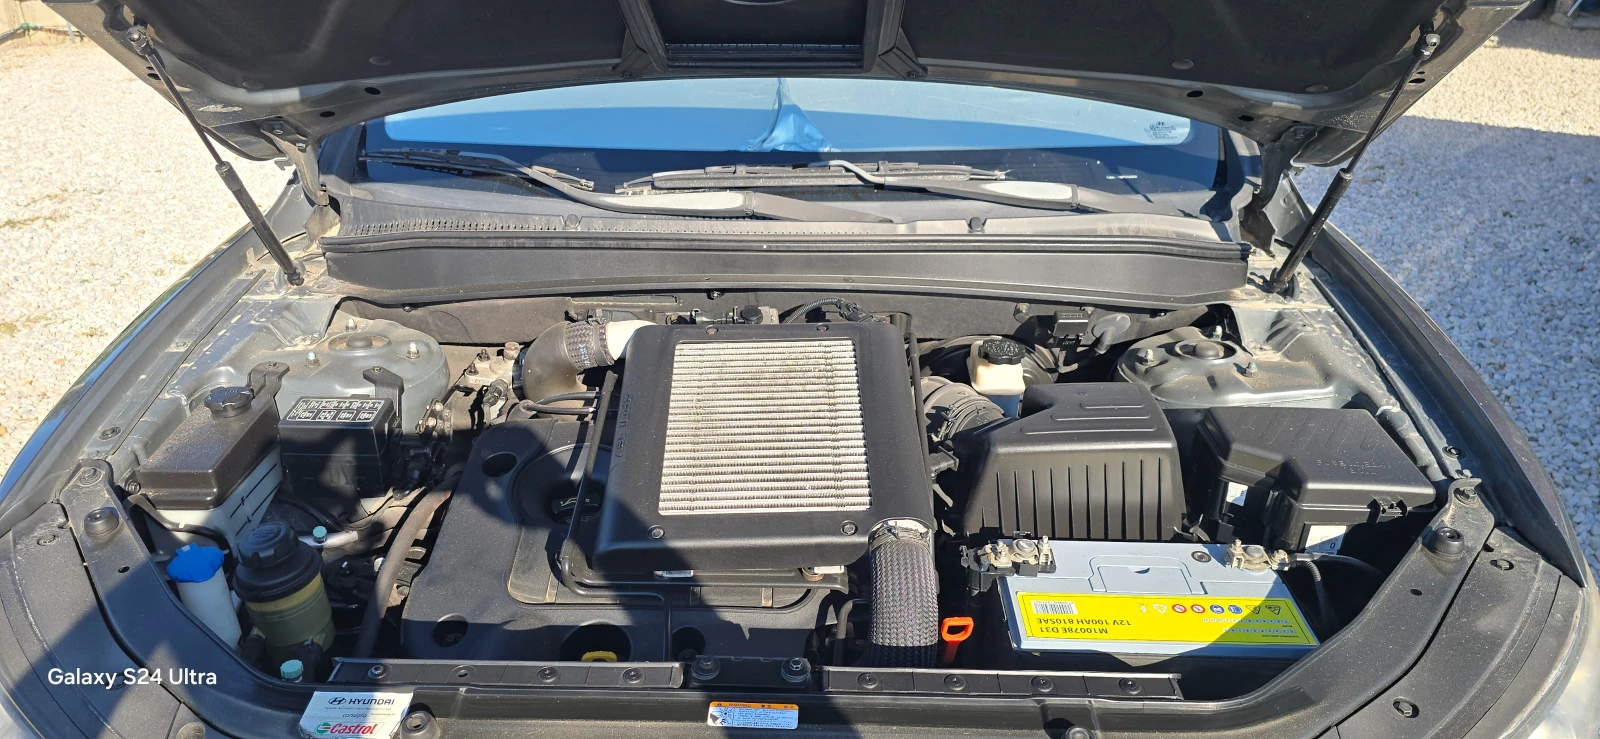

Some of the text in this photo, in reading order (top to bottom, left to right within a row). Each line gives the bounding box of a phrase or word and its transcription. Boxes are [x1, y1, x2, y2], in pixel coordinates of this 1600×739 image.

[1076, 618, 1110, 626] 100AH
[1040, 626, 1108, 634] M10078E D31
[330, 722, 378, 734] Castrol
